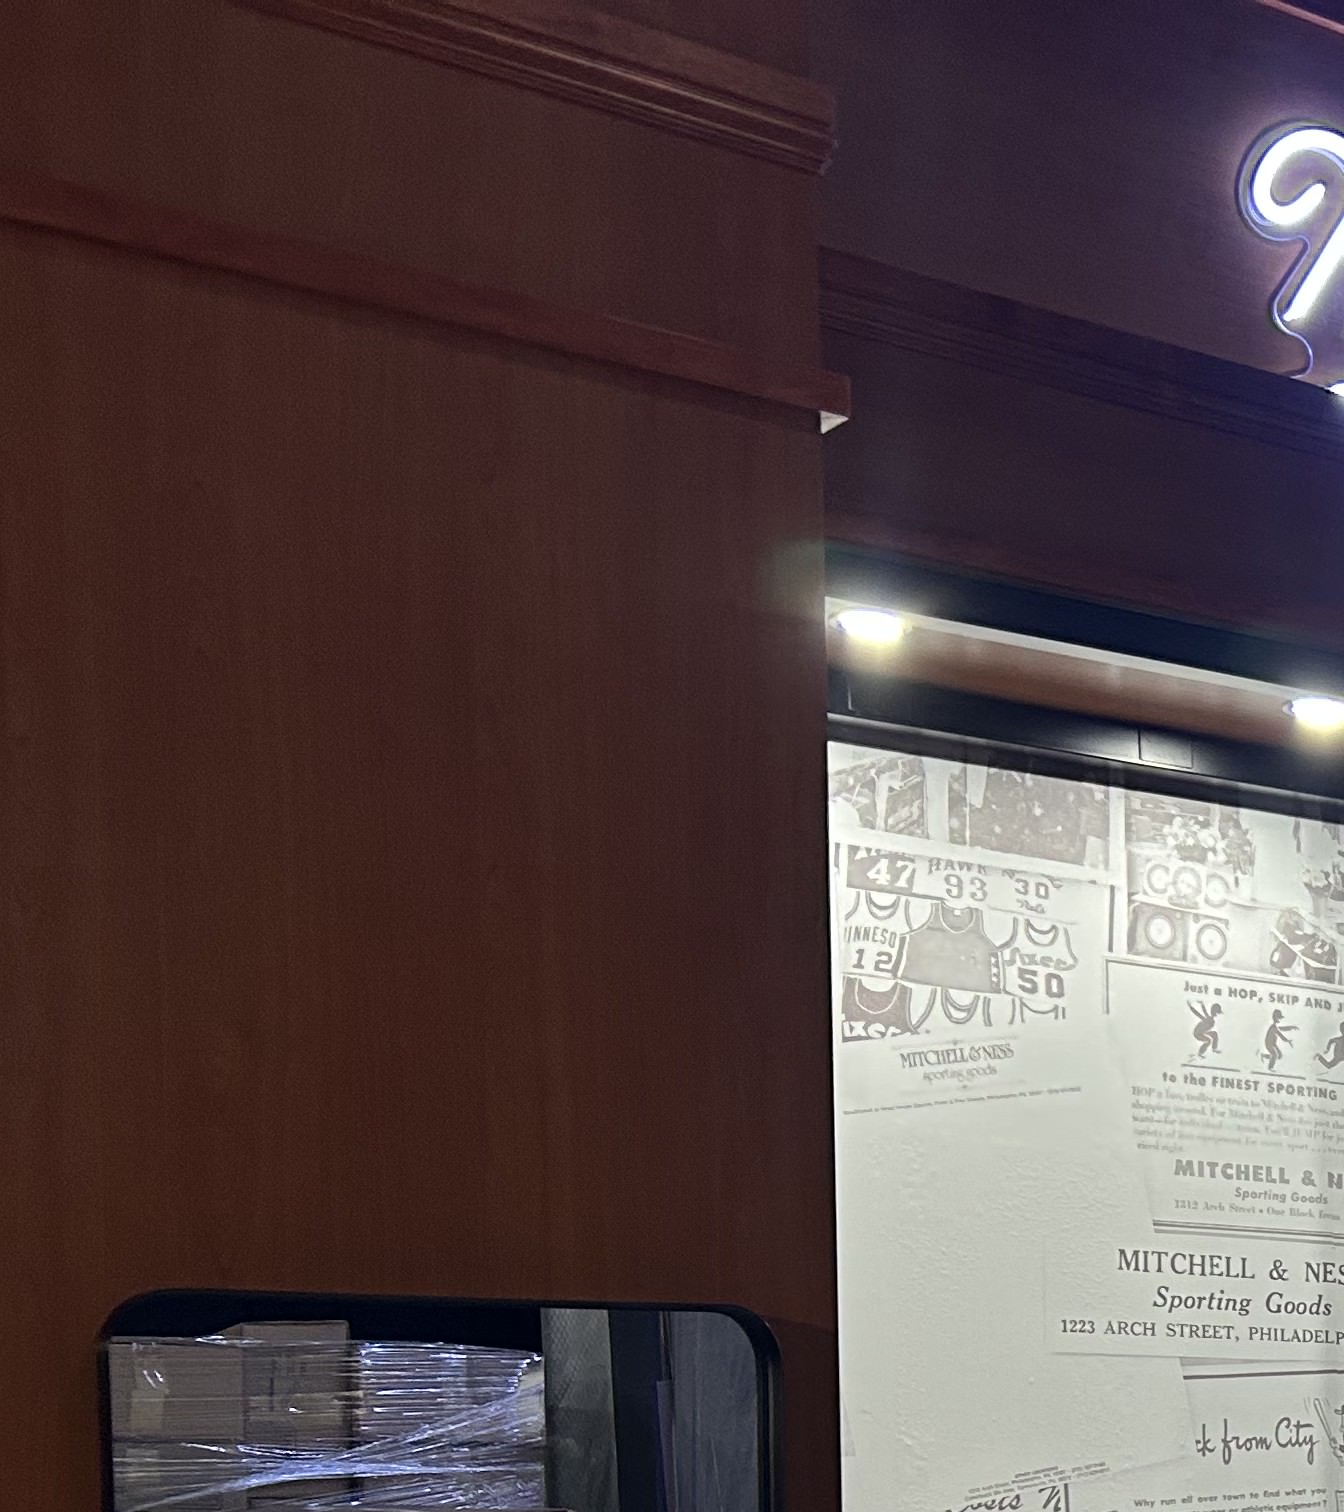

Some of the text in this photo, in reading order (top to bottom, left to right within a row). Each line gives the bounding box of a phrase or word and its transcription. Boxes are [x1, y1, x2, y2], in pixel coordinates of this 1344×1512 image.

[1017, 968, 1065, 1000] 50
[1184, 981, 1209, 995] Just
[1268, 992, 1299, 1006] SKIP
[1305, 997, 1332, 1011] AND
[1183, 1072, 1206, 1086] the
[1211, 1075, 1260, 1093] FINEST
[1267, 1081, 1338, 1102] SPORTING
[1174, 1158, 1290, 1185] MITCHELL
[1301, 1169, 1318, 1188] &
[1234, 1186, 1330, 1206] Sporting Goods
[1117, 1248, 1256, 1281] MITCHELL
[1269, 1259, 1289, 1282] &
[1152, 1285, 1334, 1318] Sporting Goods
[1060, 1319, 1096, 1335] 1223
[1103, 1321, 1157, 1337] ARCH
[1166, 1322, 1241, 1343] STREET,
